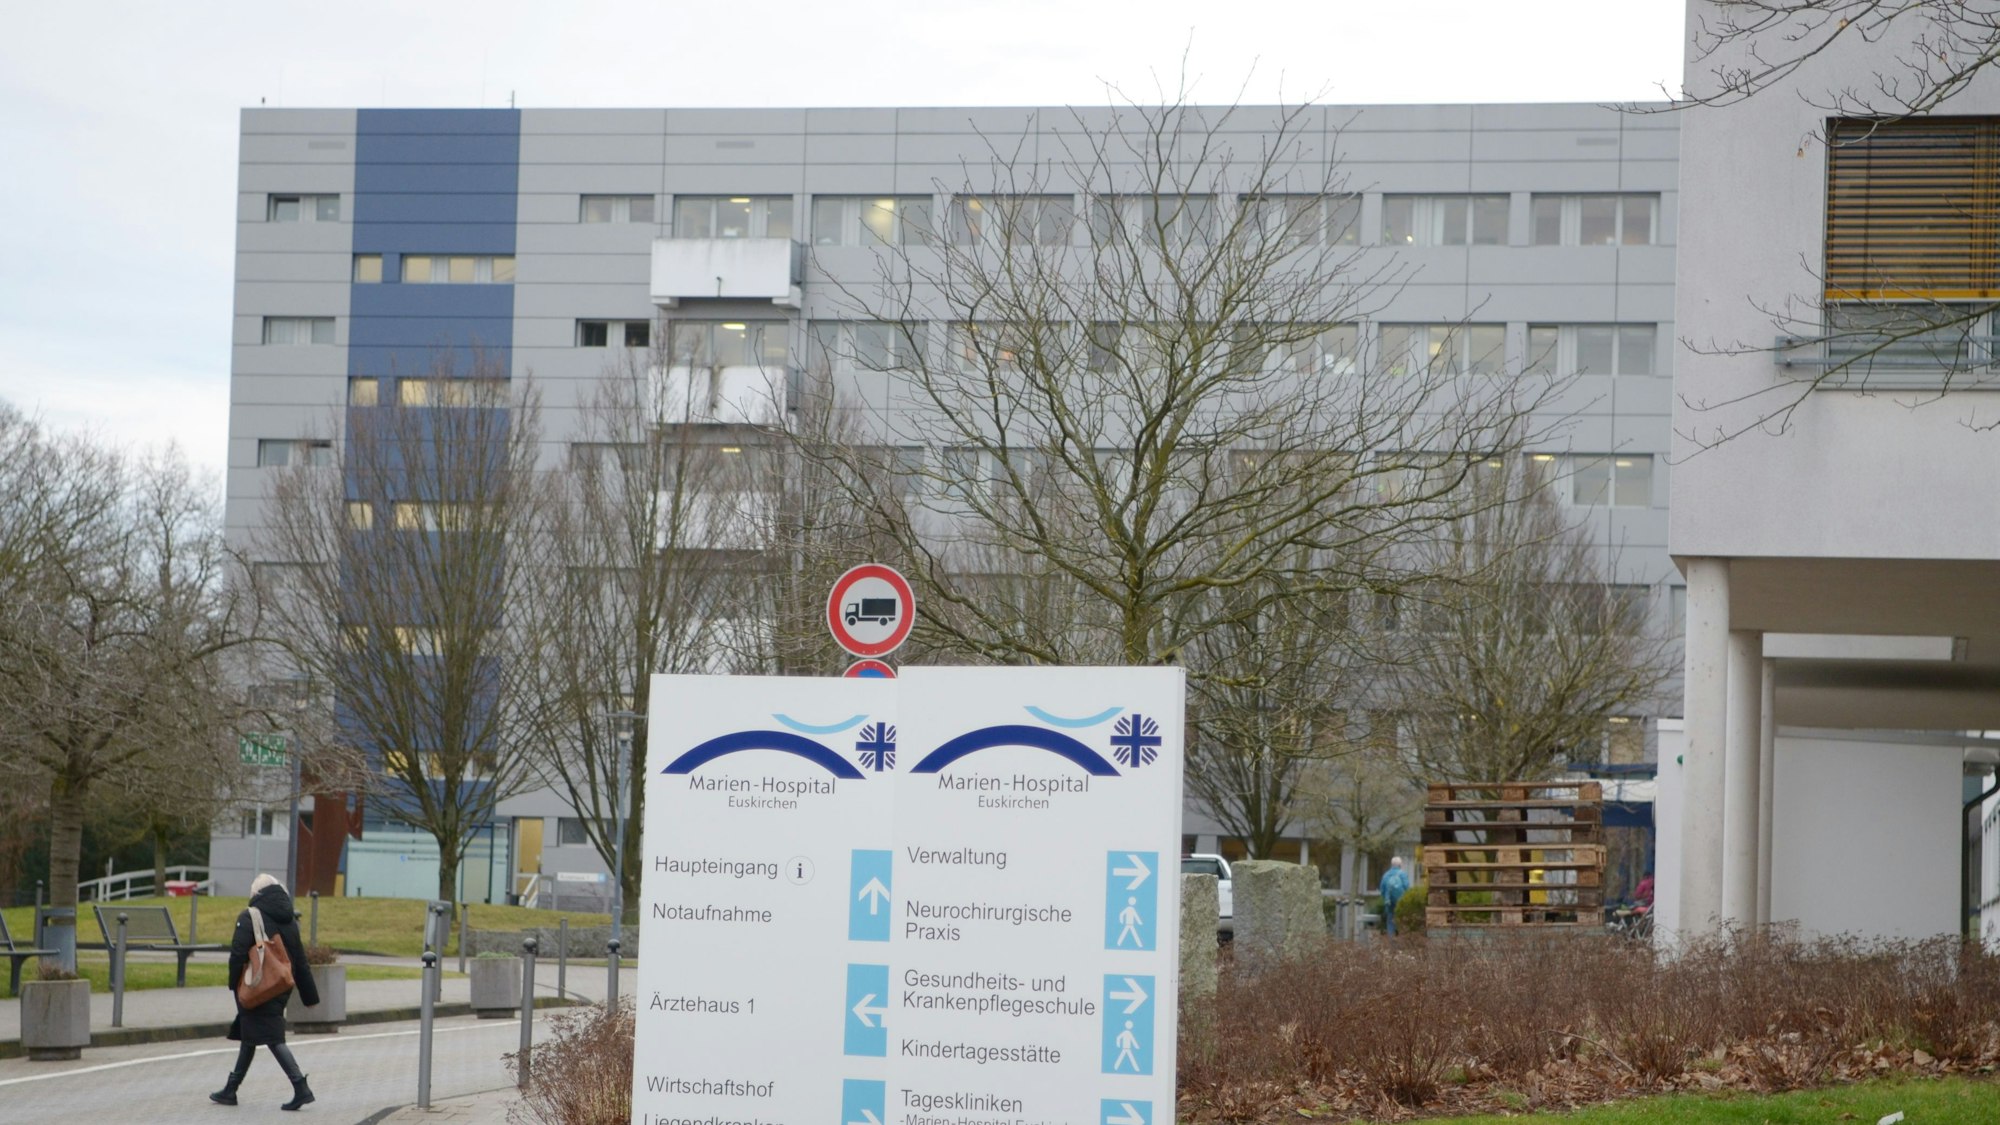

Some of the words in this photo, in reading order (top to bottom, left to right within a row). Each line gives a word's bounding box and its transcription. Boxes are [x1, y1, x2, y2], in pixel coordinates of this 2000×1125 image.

[728, 795, 798, 809] Euskirchen
[978, 794, 1050, 809] Euskirchen
[655, 856, 778, 879] Haupteingang
[907, 846, 1008, 870] Verwaltung
[653, 903, 772, 923] Notaufnahme
[906, 900, 1072, 925] Neurochirurgische
[905, 922, 961, 941] Praxis
[904, 969, 1025, 990] Gesundheits-
[1031, 976, 1066, 992] und
[650, 992, 740, 1013] Ärztehaus
[747, 998, 755, 1014] 1
[903, 990, 1096, 1017] Krankenpflegeschule
[901, 1039, 1061, 1064] Kindertagesstätte
[647, 1075, 775, 1097] Wirtschaftshof
[900, 1089, 1023, 1112] Tageskliniken
